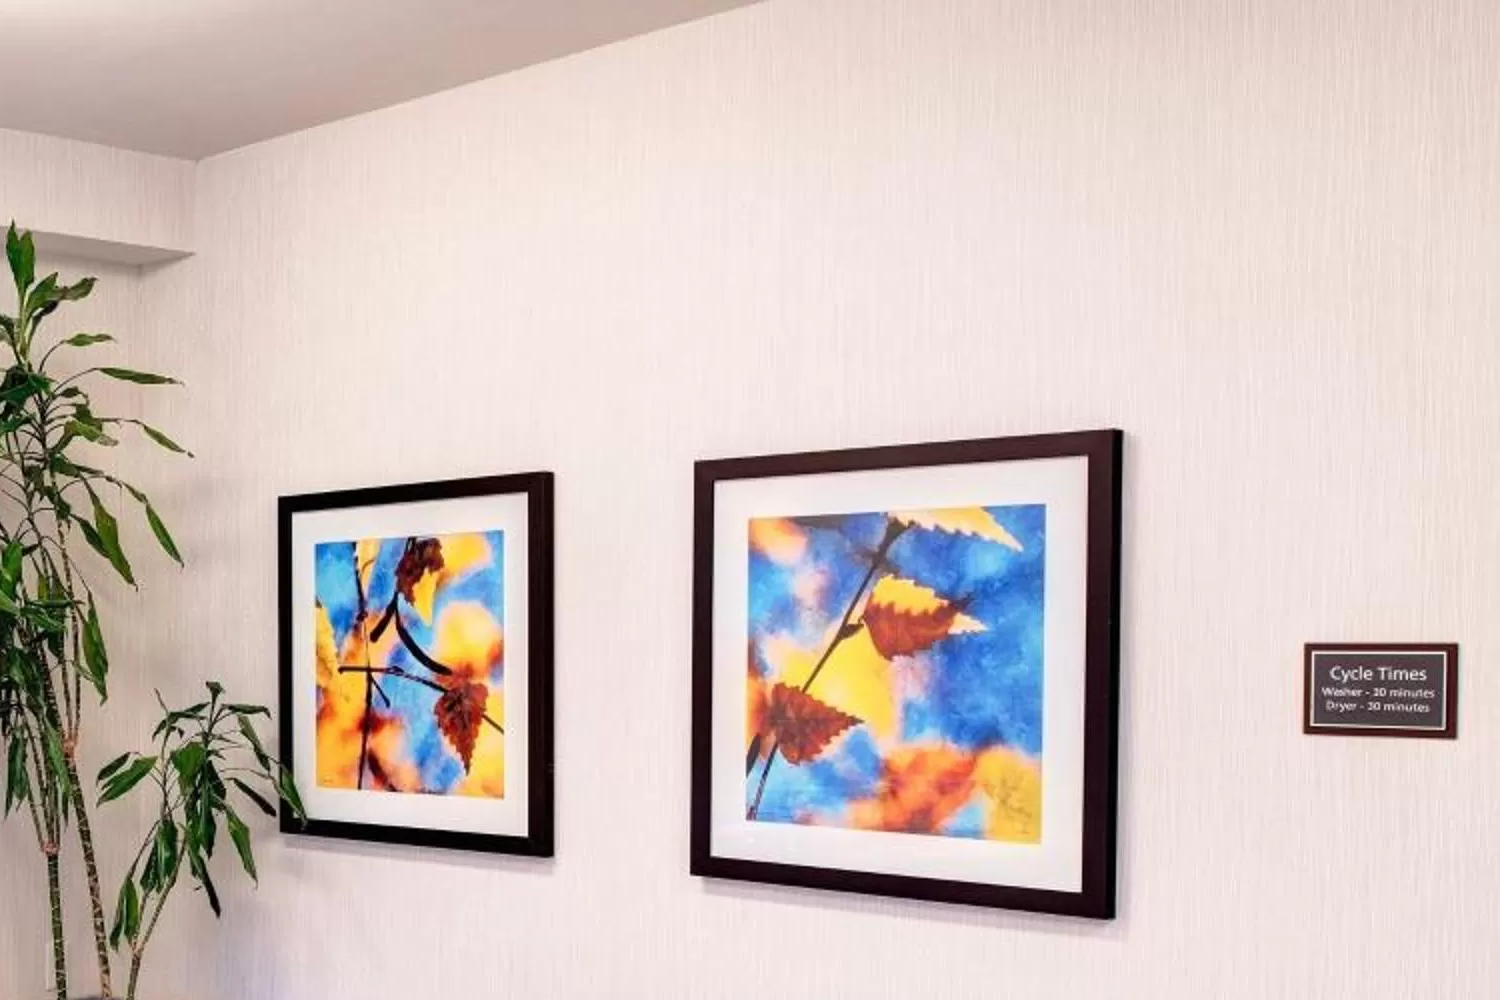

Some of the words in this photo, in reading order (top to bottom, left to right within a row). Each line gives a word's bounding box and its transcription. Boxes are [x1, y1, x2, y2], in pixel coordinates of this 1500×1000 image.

[1329, 665, 1373, 684] Cycle
[1377, 666, 1428, 681] Times
[1321, 687, 1363, 697] Washer
[1389, 688, 1435, 699] minutes
[1325, 701, 1357, 713] Dryer
[1383, 703, 1430, 713] minutes
